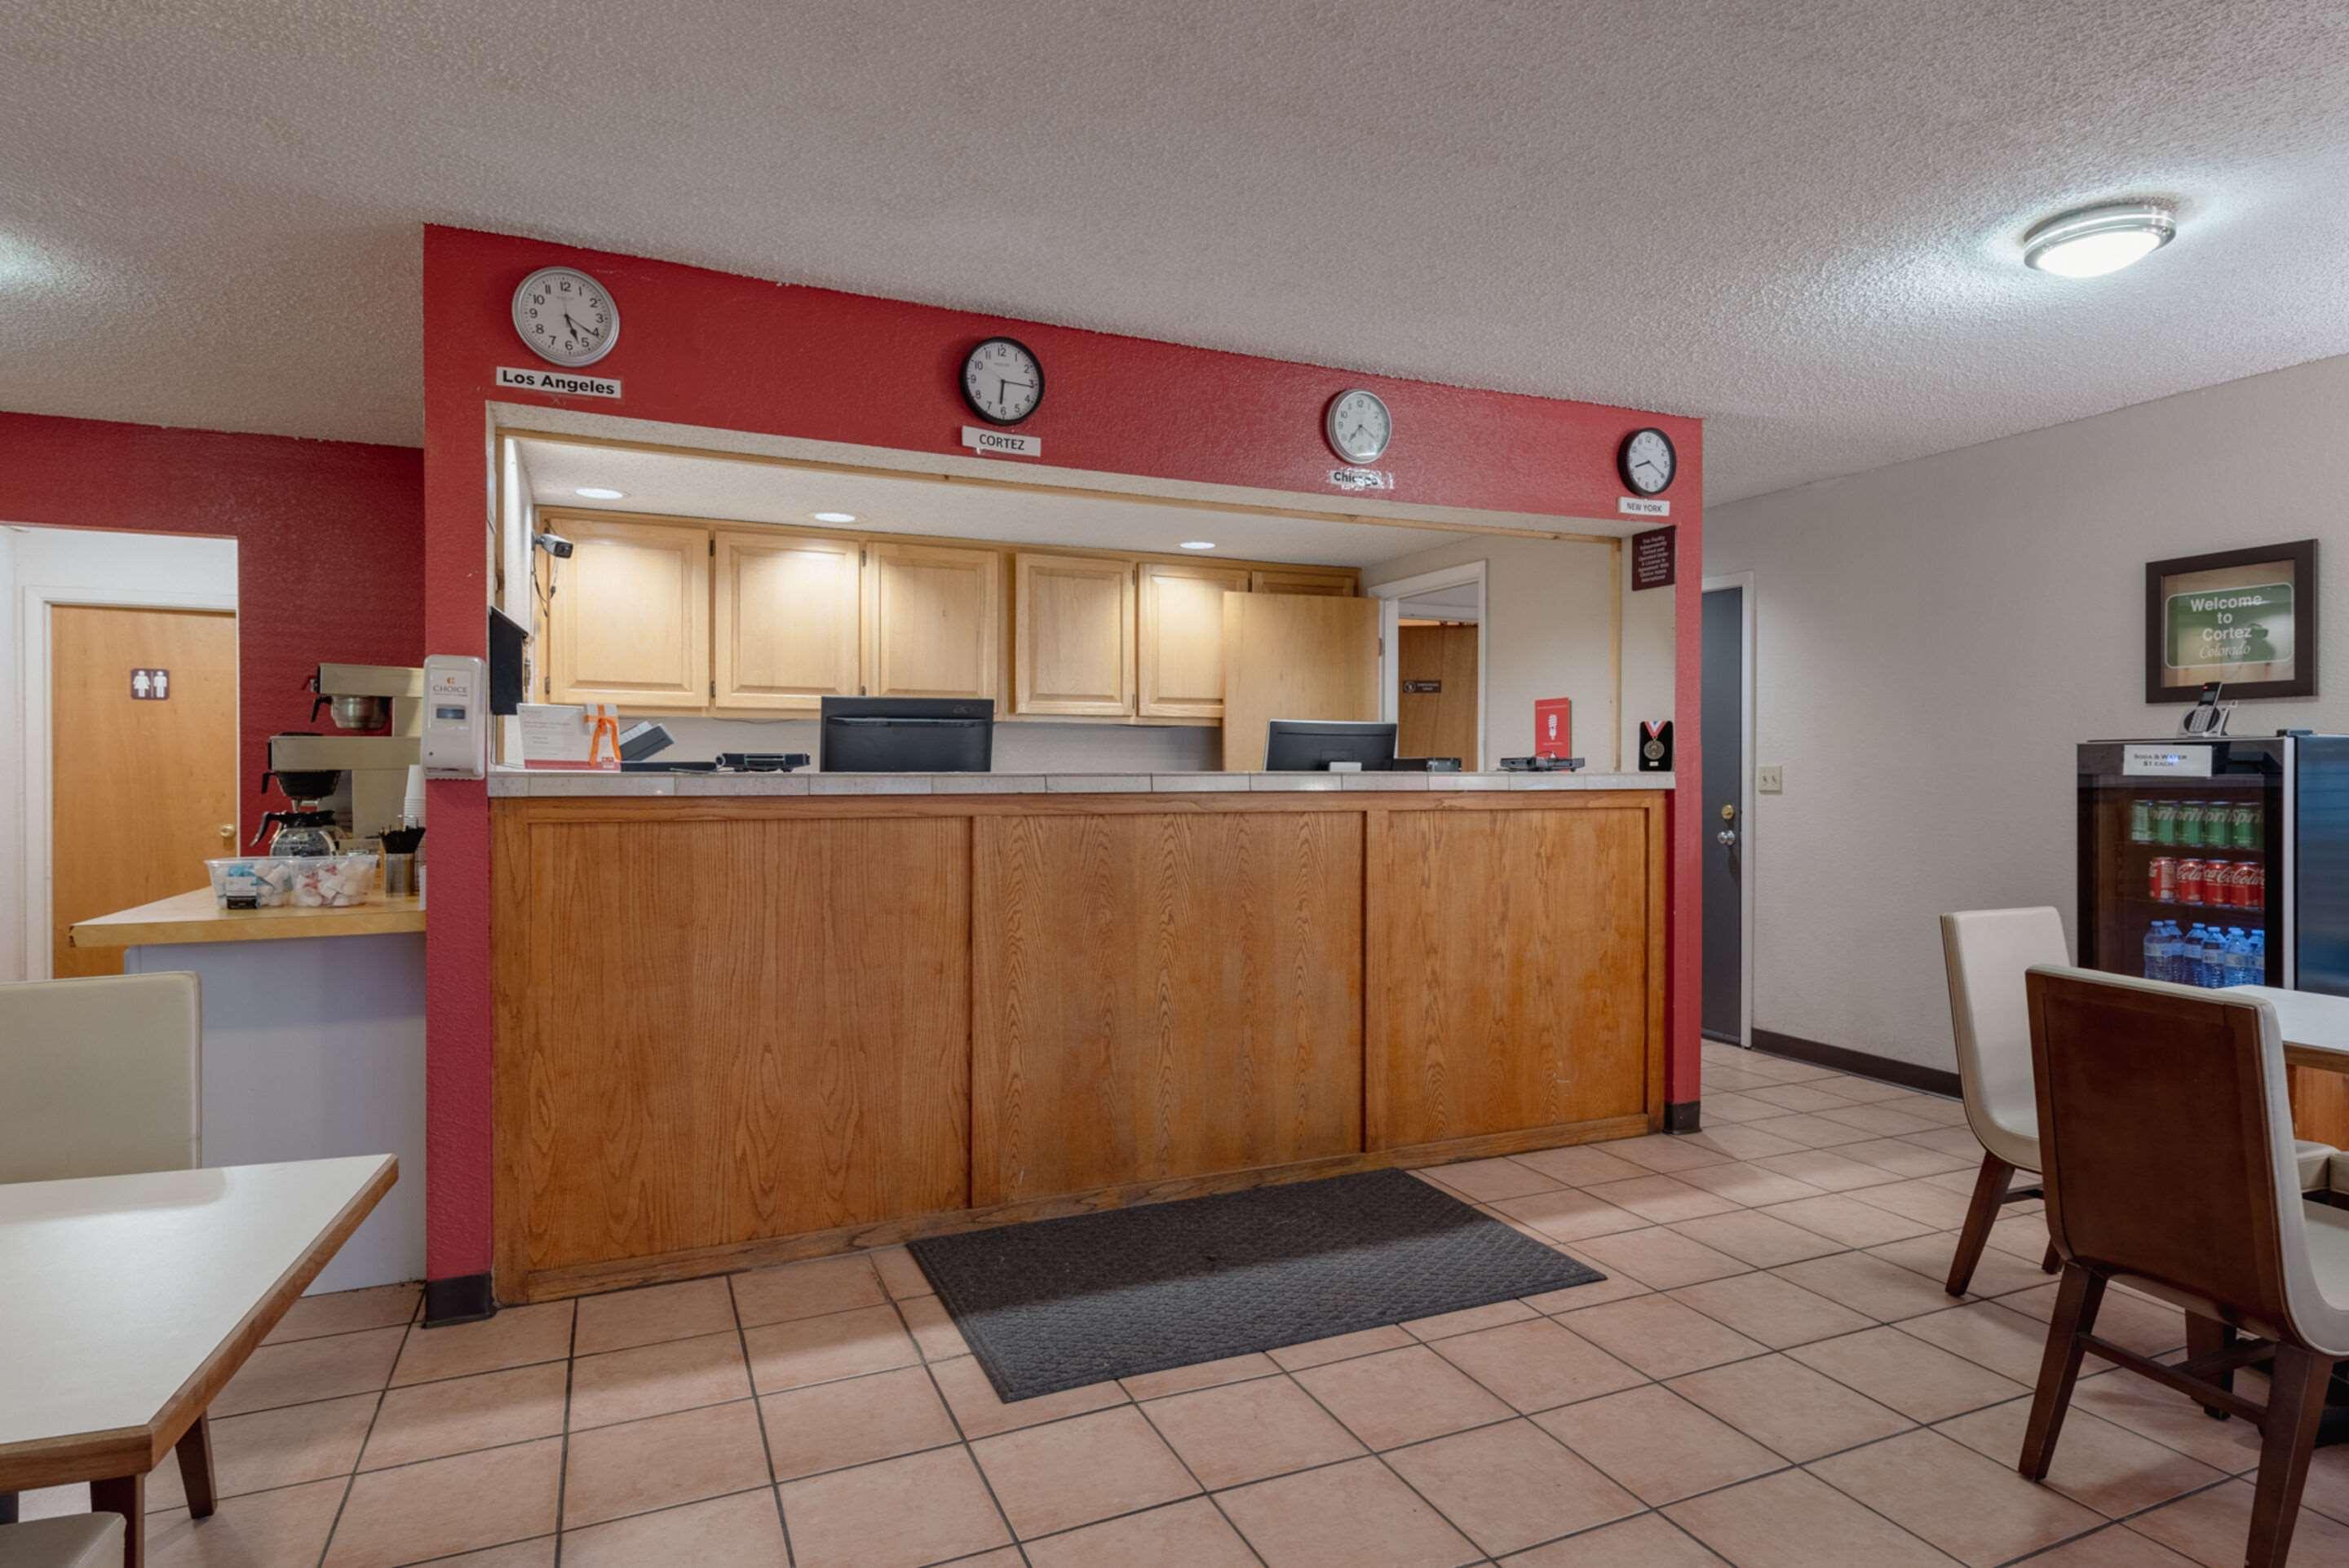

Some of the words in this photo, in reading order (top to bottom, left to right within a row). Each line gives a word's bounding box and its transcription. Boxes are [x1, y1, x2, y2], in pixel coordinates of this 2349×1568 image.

[544, 284, 551, 294] 11
[560, 280, 571, 292] 12
[577, 285, 582, 296] 1
[533, 294, 545, 305] 10
[590, 298, 598, 308] 2
[529, 307, 538, 319] 9
[595, 312, 604, 324] 3
[536, 323, 545, 334] 8
[548, 335, 557, 346] 7
[564, 340, 573, 351] 6
[582, 337, 590, 347] 5
[985, 350, 992, 360] 11
[998, 347, 1007, 357] 12
[975, 360, 984, 371] 10
[1024, 364, 1030, 373] 2
[502, 369, 535, 385] Los
[540, 374, 616, 395] Angeles
[970, 374, 976, 384] 9
[975, 390, 982, 400] 8
[1024, 394, 1031, 404] 4
[986, 400, 993, 410] 7
[1014, 404, 1020, 413] 5
[1000, 406, 1006, 416] 6
[979, 434, 1025, 450] CORTEZ
[1626, 501, 1642, 511] NEW
[1643, 503, 1662, 513] YORK
[2190, 595, 2263, 612] Welcome
[2216, 612, 2233, 625] to
[2202, 626, 2252, 641] Cortez
[2199, 638, 2251, 659] Colorado
[432, 684, 468, 694] CHOICE
